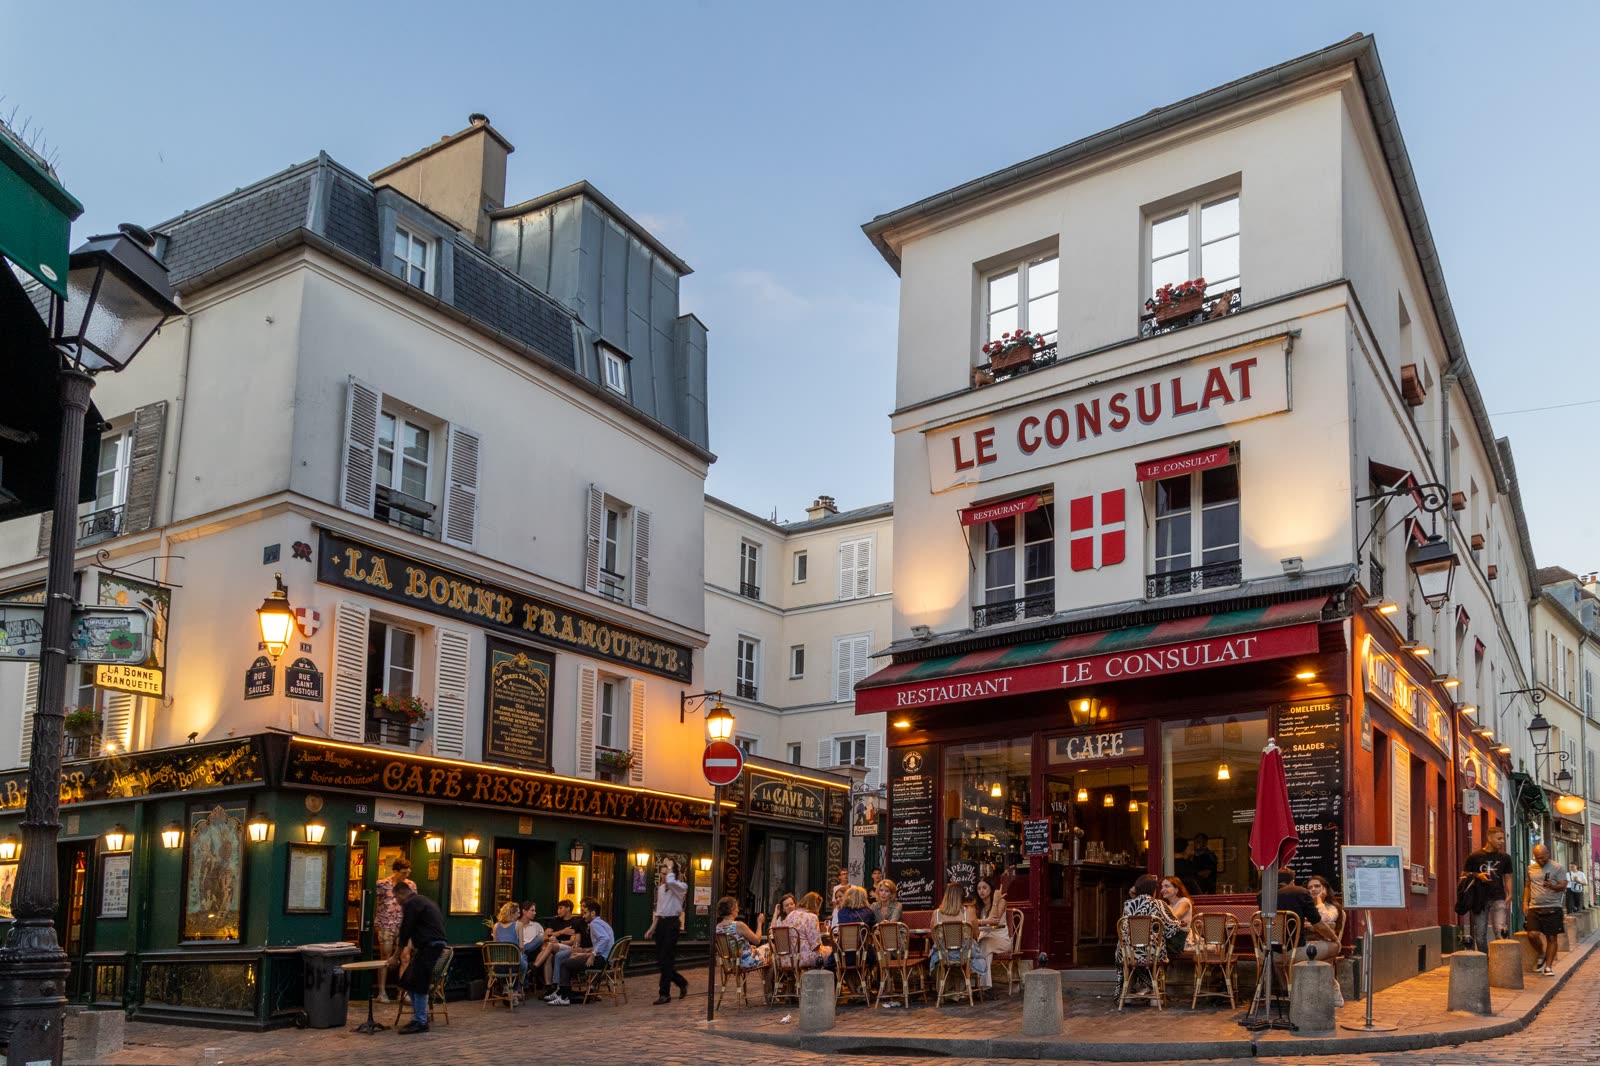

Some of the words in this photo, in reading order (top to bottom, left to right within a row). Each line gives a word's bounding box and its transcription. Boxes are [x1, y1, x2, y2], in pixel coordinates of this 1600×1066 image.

[952, 427, 998, 472] LE
[1017, 357, 1258, 457] CONSULAT
[1147, 465, 1160, 477] LE
[1163, 453, 1218, 472] CONSULAT
[973, 501, 1027, 521] RESTAURANT
[344, 547, 393, 591] LA
[405, 566, 514, 624] BONNE
[522, 602, 679, 672] FRANQUETTE
[302, 643, 310, 651] 18
[107, 664, 120, 675] LA
[123, 667, 154, 681] BONNE
[253, 671, 267, 681] RUE
[298, 673, 311, 681] RUE
[896, 676, 1012, 706] RESTAURANT
[1061, 661, 1093, 685] LE
[1105, 636, 1258, 678] CONSULAT
[100, 672, 159, 692] FRANQUETTE
[296, 680, 313, 689] SAINT
[248, 684, 271, 695] SAULES
[290, 686, 319, 697] RUSTIQUE
[1290, 704, 1331, 714] OMELETTES
[1292, 743, 1325, 752] SALADES
[311, 770, 334, 784] Boire
[382, 761, 462, 798] CAFÉ
[472, 772, 634, 817] RESTAURANT
[642, 796, 683, 823] VINS
[762, 787, 771, 800] LA
[772, 787, 804, 808] CAVE
[805, 796, 815, 808] DE
[785, 806, 814, 818] FRANQUETTE
[1051, 801, 1067, 814] VINS
[1295, 823, 1323, 831] CRÊPES
[946, 862, 976, 877] APÉROL
